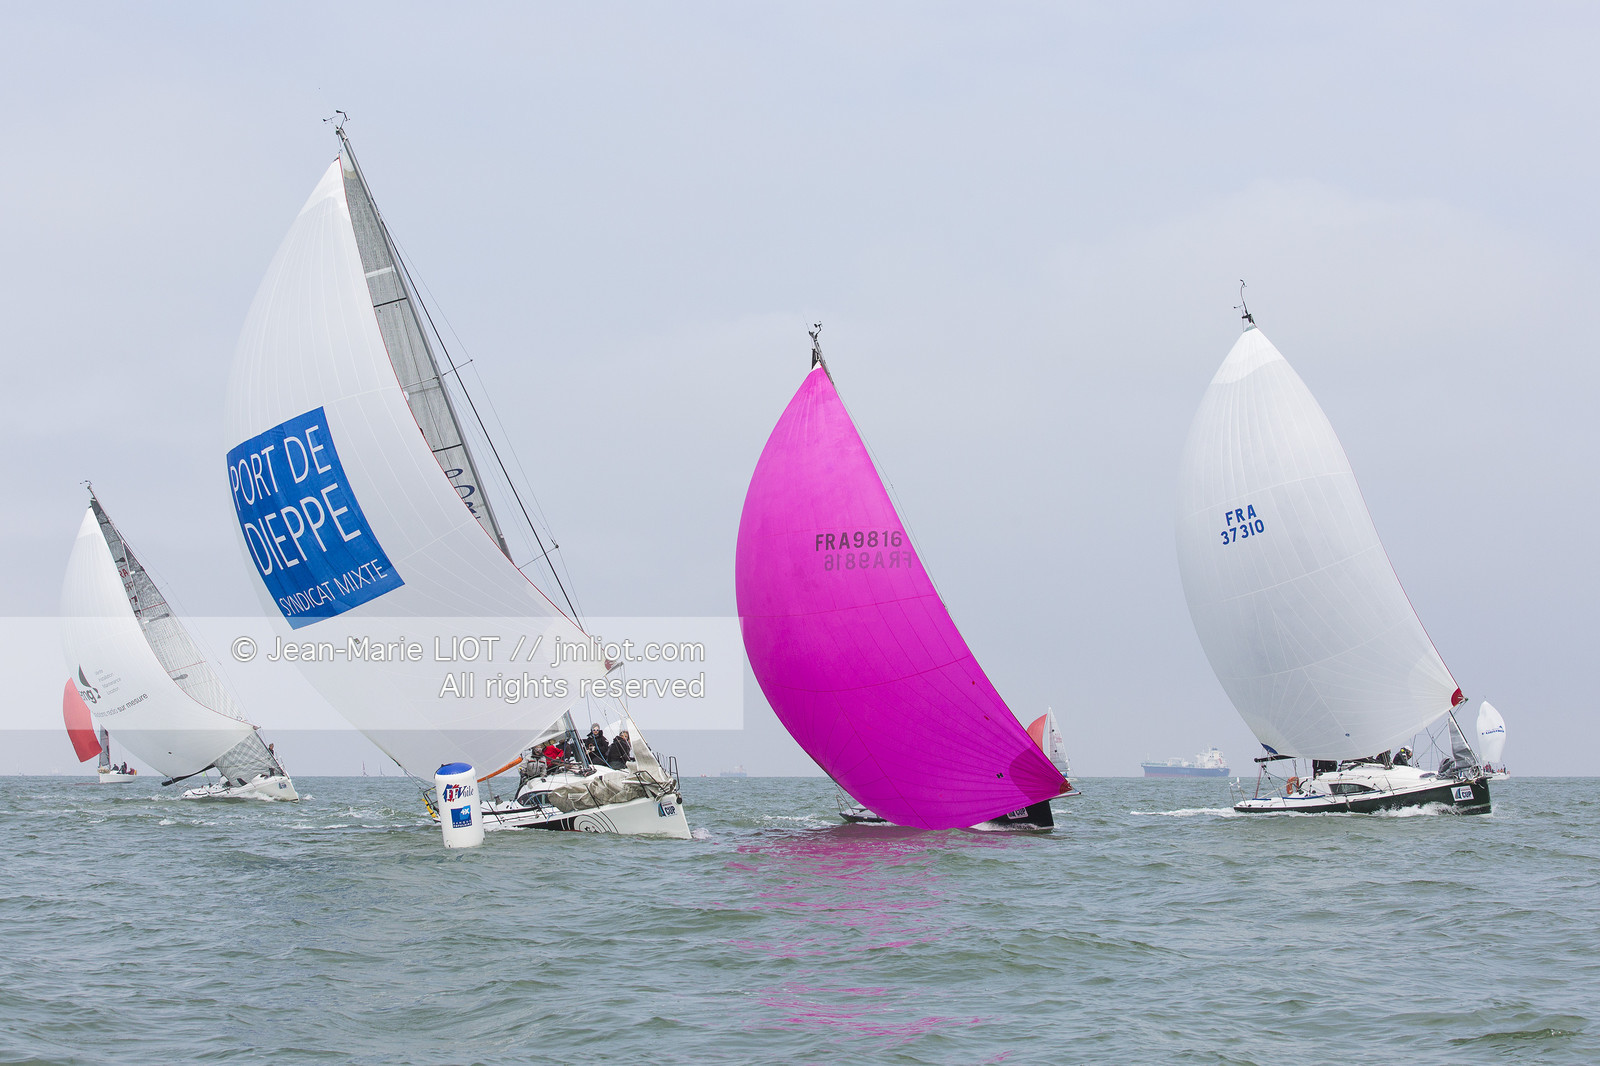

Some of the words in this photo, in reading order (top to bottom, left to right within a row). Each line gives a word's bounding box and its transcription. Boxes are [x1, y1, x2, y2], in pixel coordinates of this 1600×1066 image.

[229, 445, 279, 511] PORT
[283, 424, 332, 484] DE
[244, 482, 362, 576] DIEPPE
[1220, 519, 1265, 545] 37310
[1225, 504, 1257, 526] FRA
[815, 530, 903, 551] FRA9816
[279, 581, 336, 617] SYNDICAT
[333, 558, 388, 596] MIXTE
